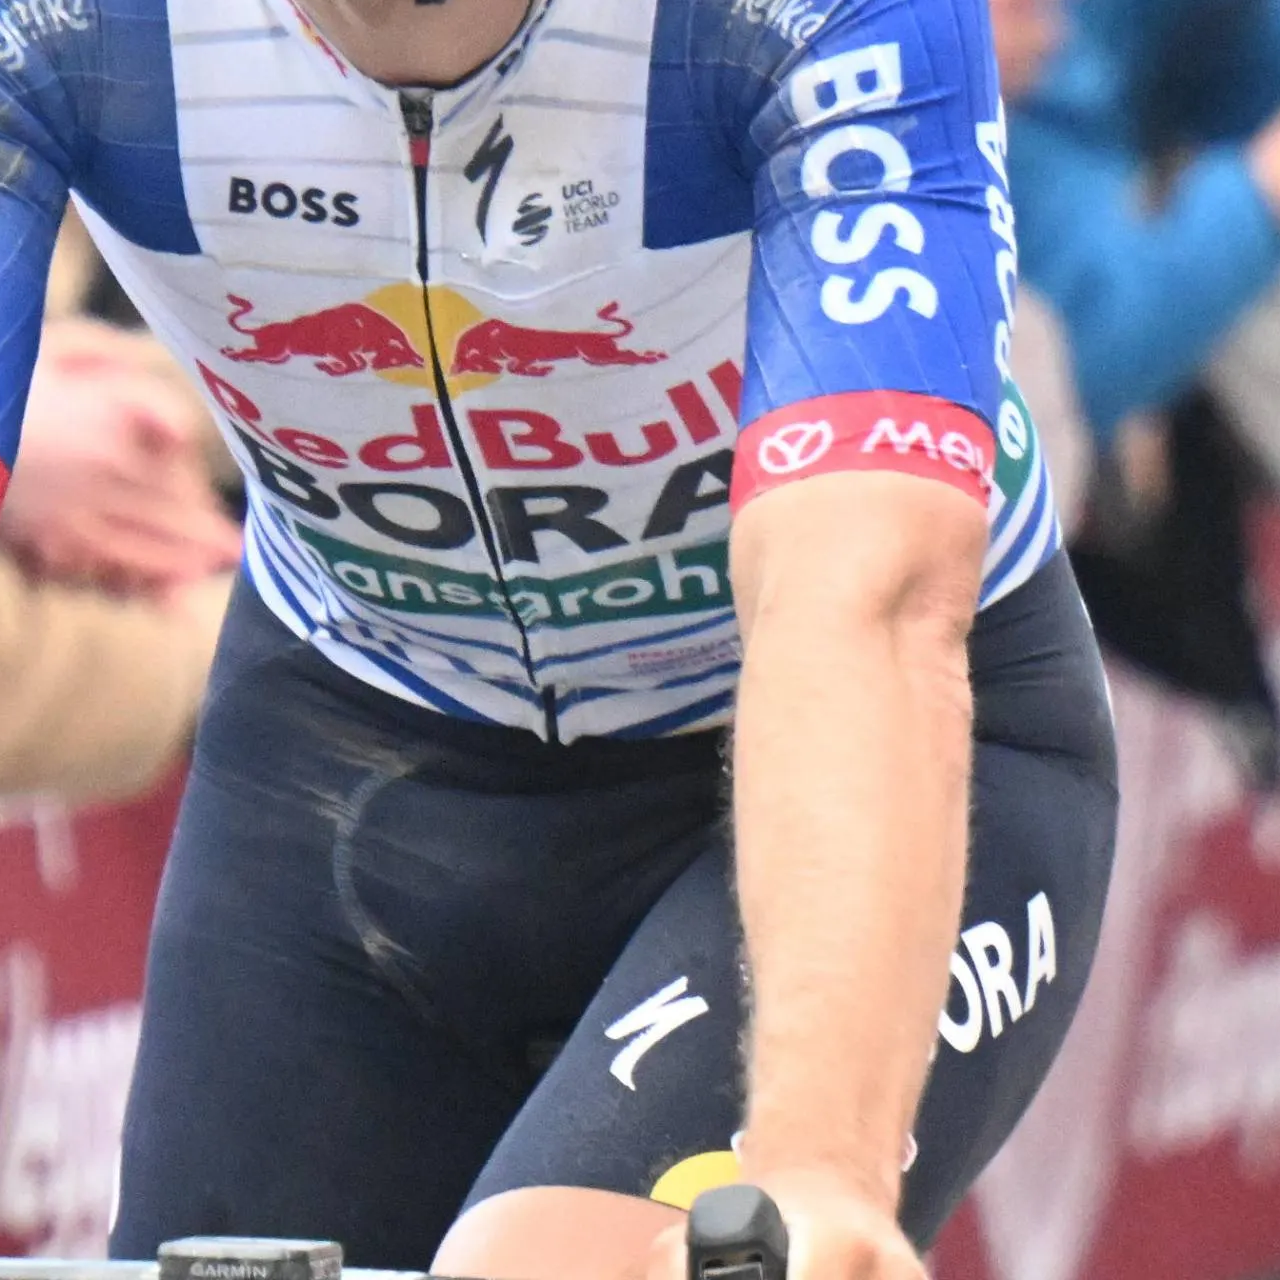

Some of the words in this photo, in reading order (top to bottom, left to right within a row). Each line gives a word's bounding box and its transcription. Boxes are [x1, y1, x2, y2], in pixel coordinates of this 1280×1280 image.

[228, 176, 361, 228] BOSS
[562, 180, 593, 200] UCI
[563, 191, 620, 218] WORLD
[790, 42, 938, 325] BOSS
[564, 210, 609, 235] TEAM
[195, 358, 454, 472] Red
[466, 358, 744, 471] Bull
[228, 419, 735, 565] BORA
[937, 891, 1057, 1054] ORA
[190, 1261, 267, 1279] GARMIN
